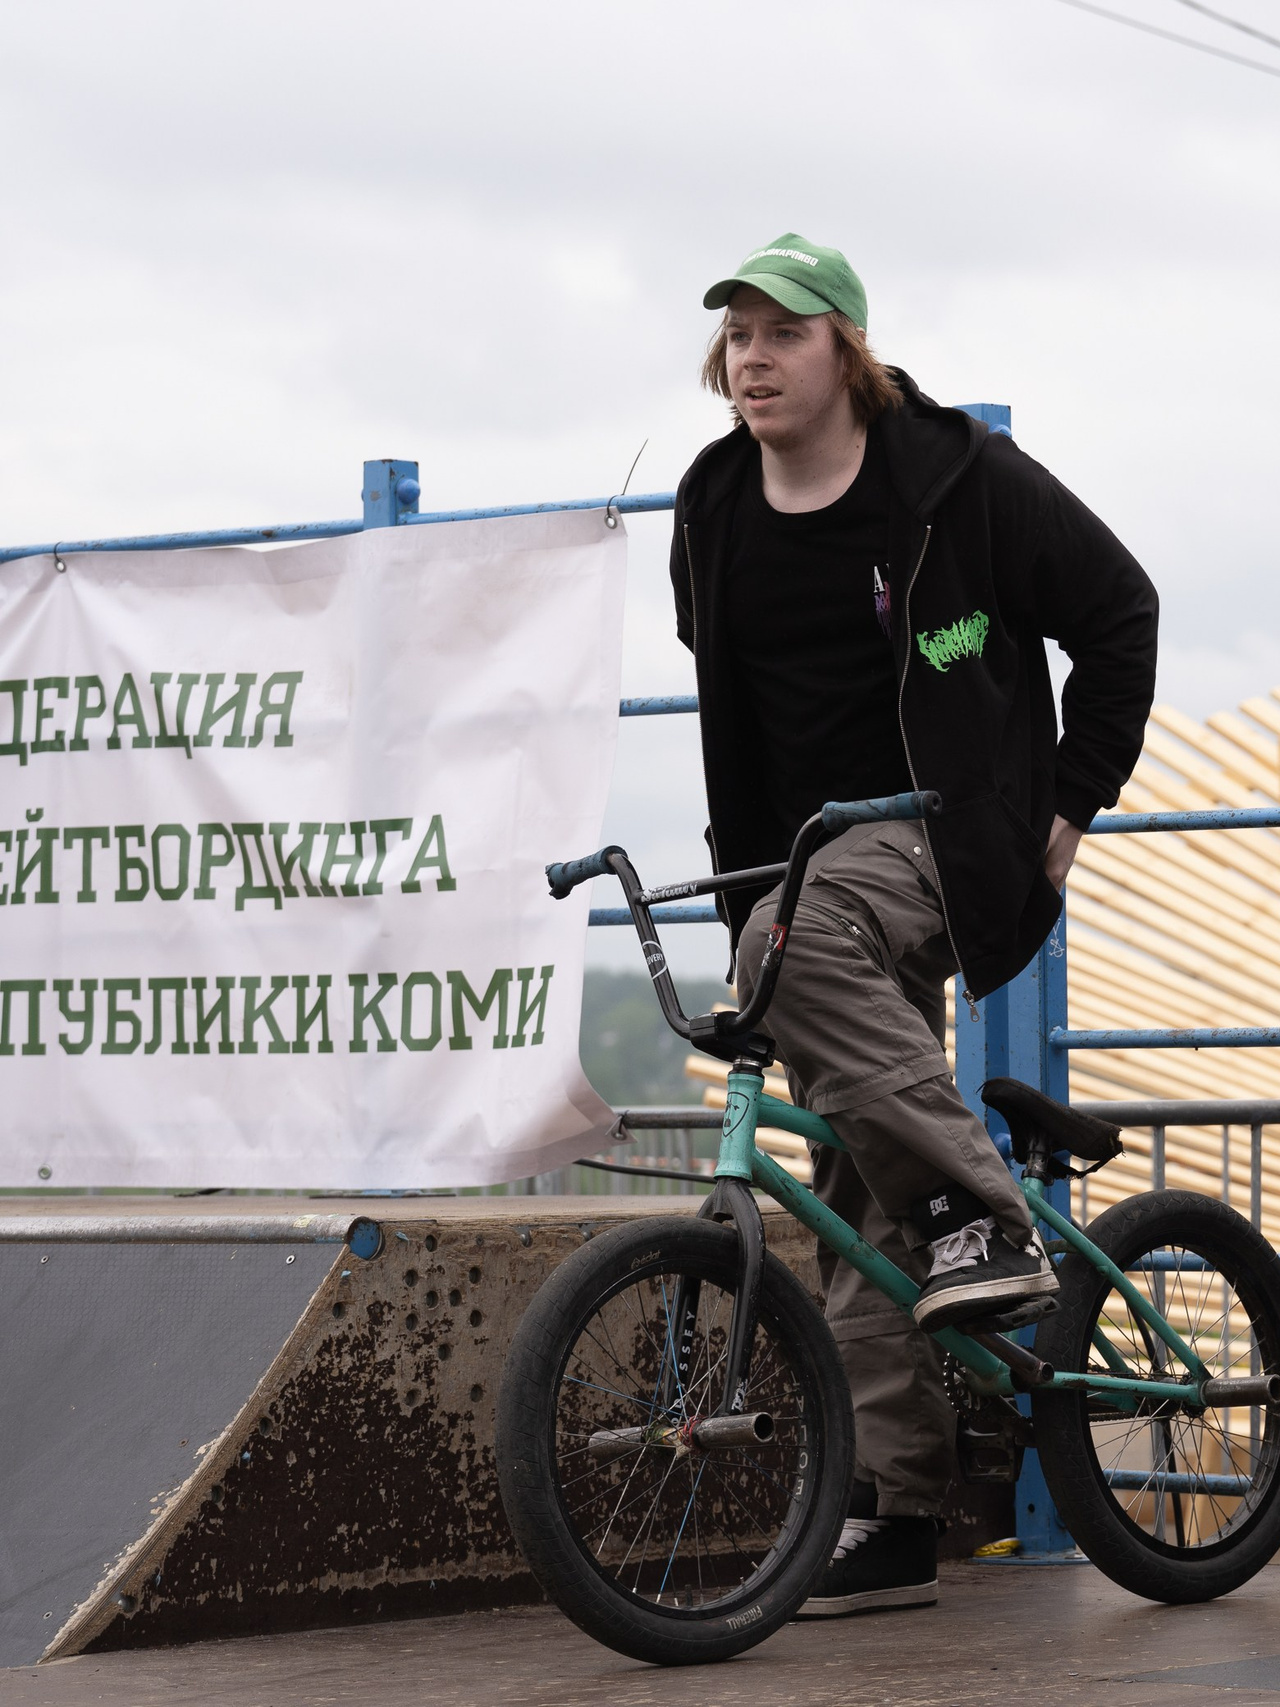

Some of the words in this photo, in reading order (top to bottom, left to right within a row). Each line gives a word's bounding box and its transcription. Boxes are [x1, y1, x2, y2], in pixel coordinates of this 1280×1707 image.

[0, 974, 334, 1055] ПУБЛИКИ
[347, 965, 555, 1054] КОМИ
[725, 1604, 763, 1630] FIREBALL
